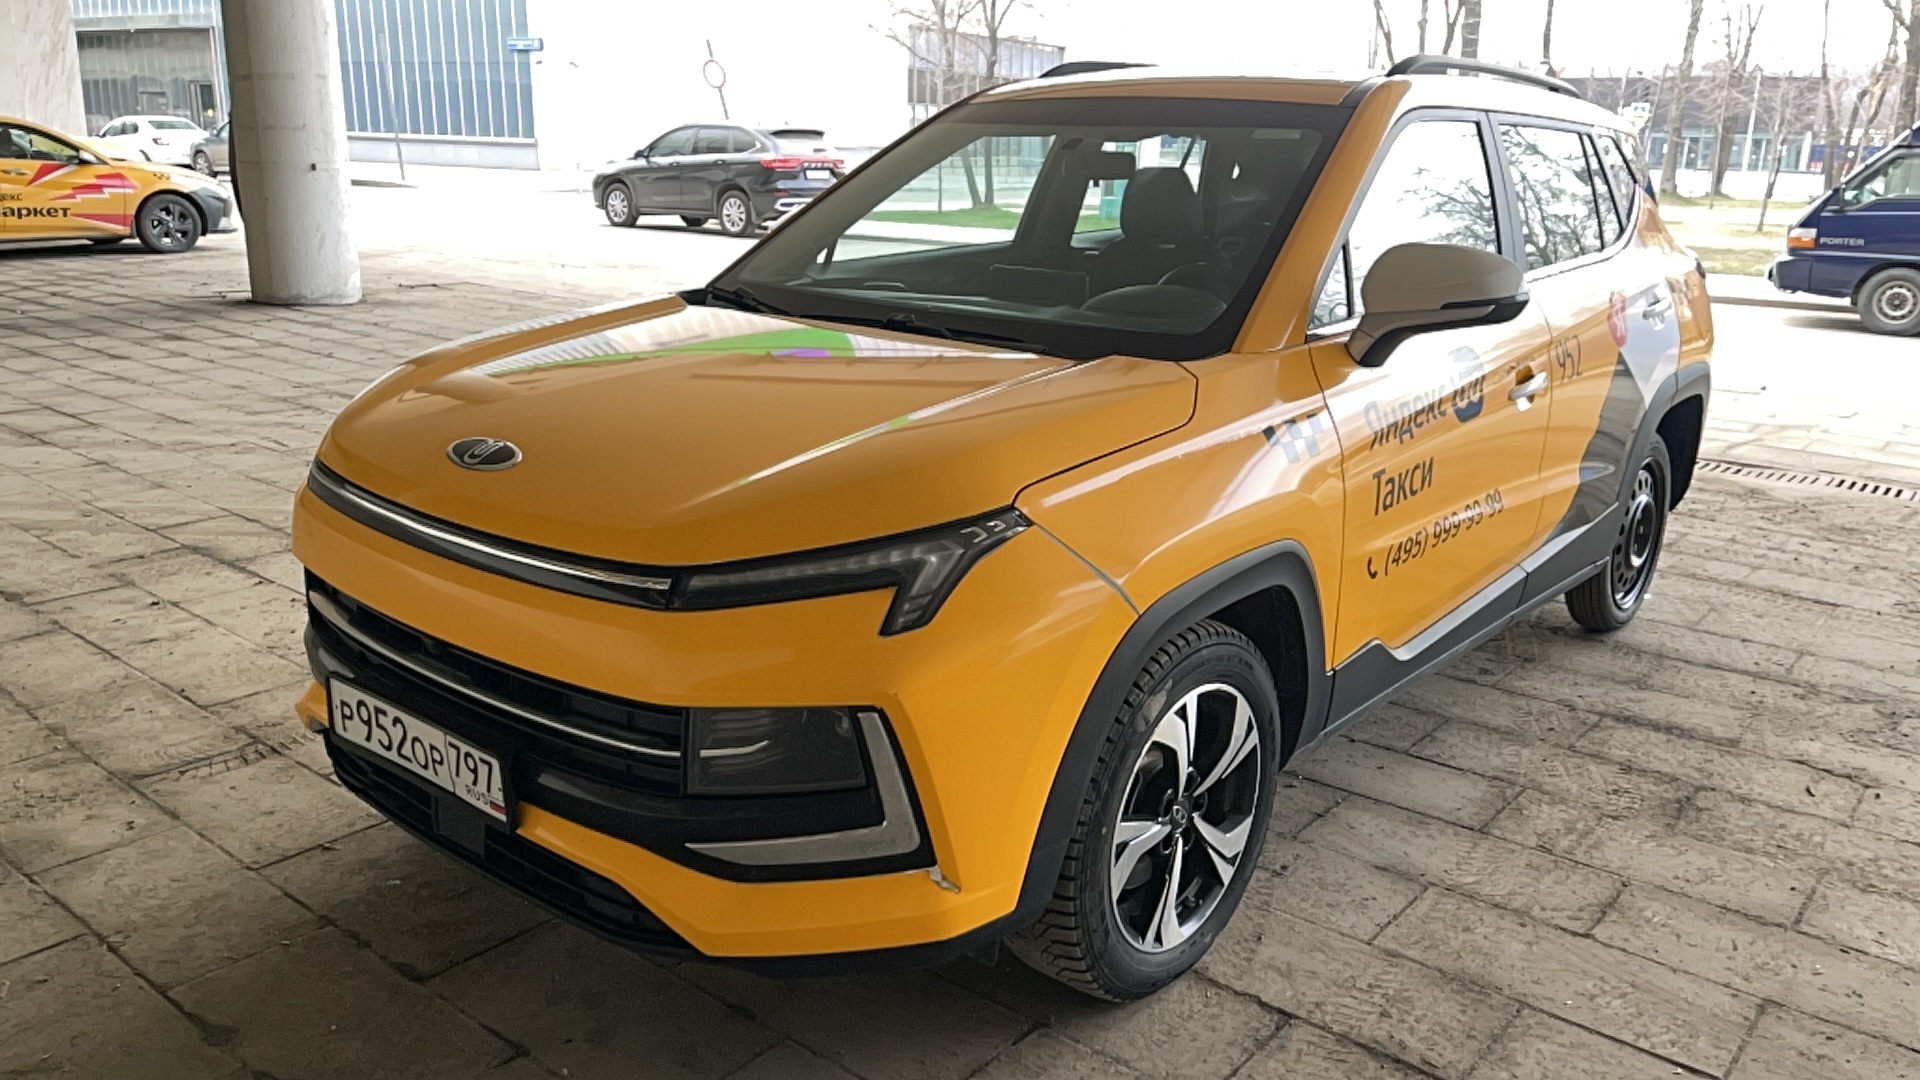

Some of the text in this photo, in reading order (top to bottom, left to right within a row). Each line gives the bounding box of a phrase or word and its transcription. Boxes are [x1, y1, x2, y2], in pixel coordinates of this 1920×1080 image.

[0, 192, 23, 202] екс
[0, 206, 71, 220] аркет
[1820, 236, 1865, 247] PORTER
[1555, 334, 1582, 381] 952
[1363, 384, 1448, 451] Яндекс
[1372, 457, 1434, 516] Такси
[1384, 488, 1504, 576] (495) 999-99-99
